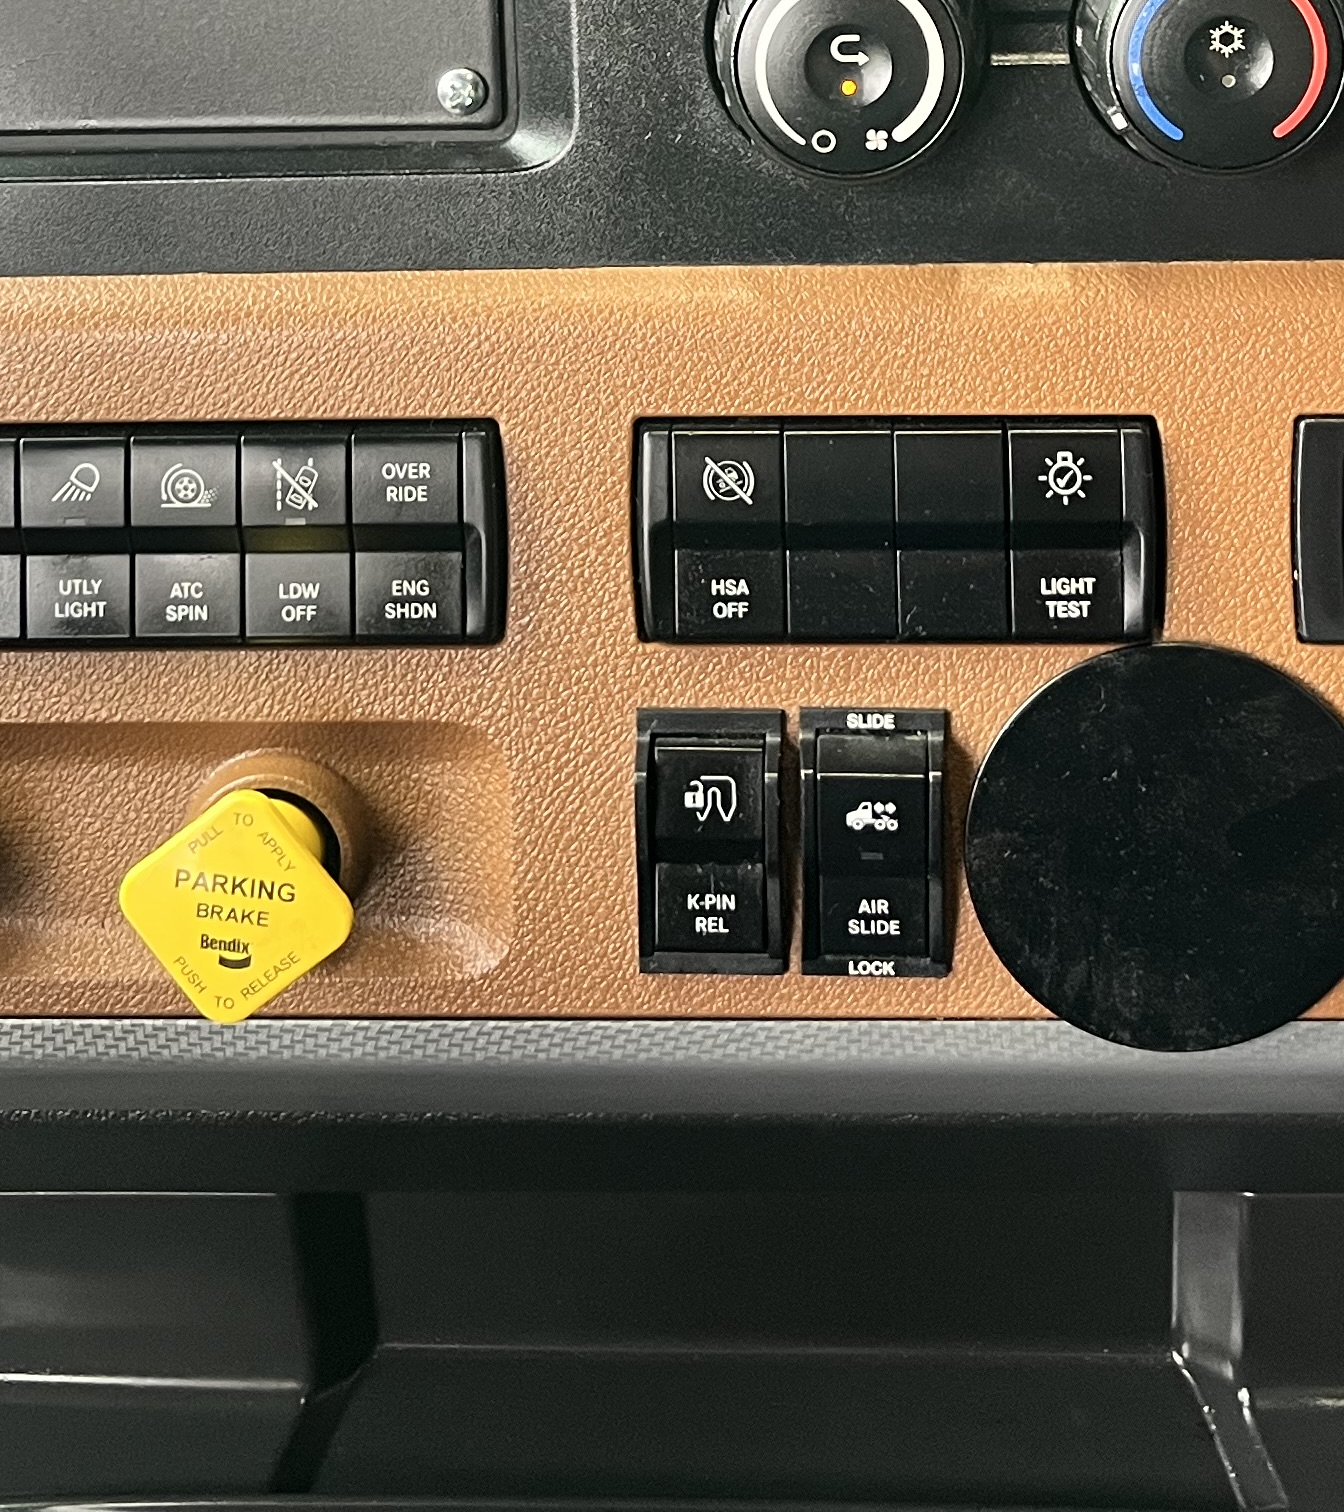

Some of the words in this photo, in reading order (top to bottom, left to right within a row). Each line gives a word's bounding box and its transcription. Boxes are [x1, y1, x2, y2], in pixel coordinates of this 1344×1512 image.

[382, 462, 431, 480] OVER
[386, 485, 429, 503] RIDE
[58, 579, 103, 597] UTLY
[169, 581, 204, 599] ATC
[278, 582, 321, 600] LDW
[391, 579, 431, 597] ENG
[711, 579, 750, 597] HSA
[1040, 577, 1096, 597] LIGHT
[54, 600, 108, 619] LIGHT
[165, 604, 209, 623] SPIN
[281, 604, 318, 623] OFF
[384, 602, 438, 620] SHDN
[712, 601, 749, 619] OFF
[1046, 600, 1091, 619] TEST
[846, 712, 896, 730] SLIDE
[187, 825, 225, 855] PULL
[233, 812, 255, 827] TO
[257, 830, 297, 874] APPLY
[174, 868, 297, 904] PARKING
[686, 893, 736, 912] K-PIN
[858, 899, 890, 916] AIR
[196, 902, 271, 929] BRAKE
[694, 916, 730, 934] REL
[847, 919, 901, 936] SLIDE
[199, 934, 251, 955] Bendix
[847, 960, 896, 978] LOCK
[173, 955, 208, 995] PUSH
[214, 995, 236, 1011] TO
[240, 951, 302, 1001] RELEASE
